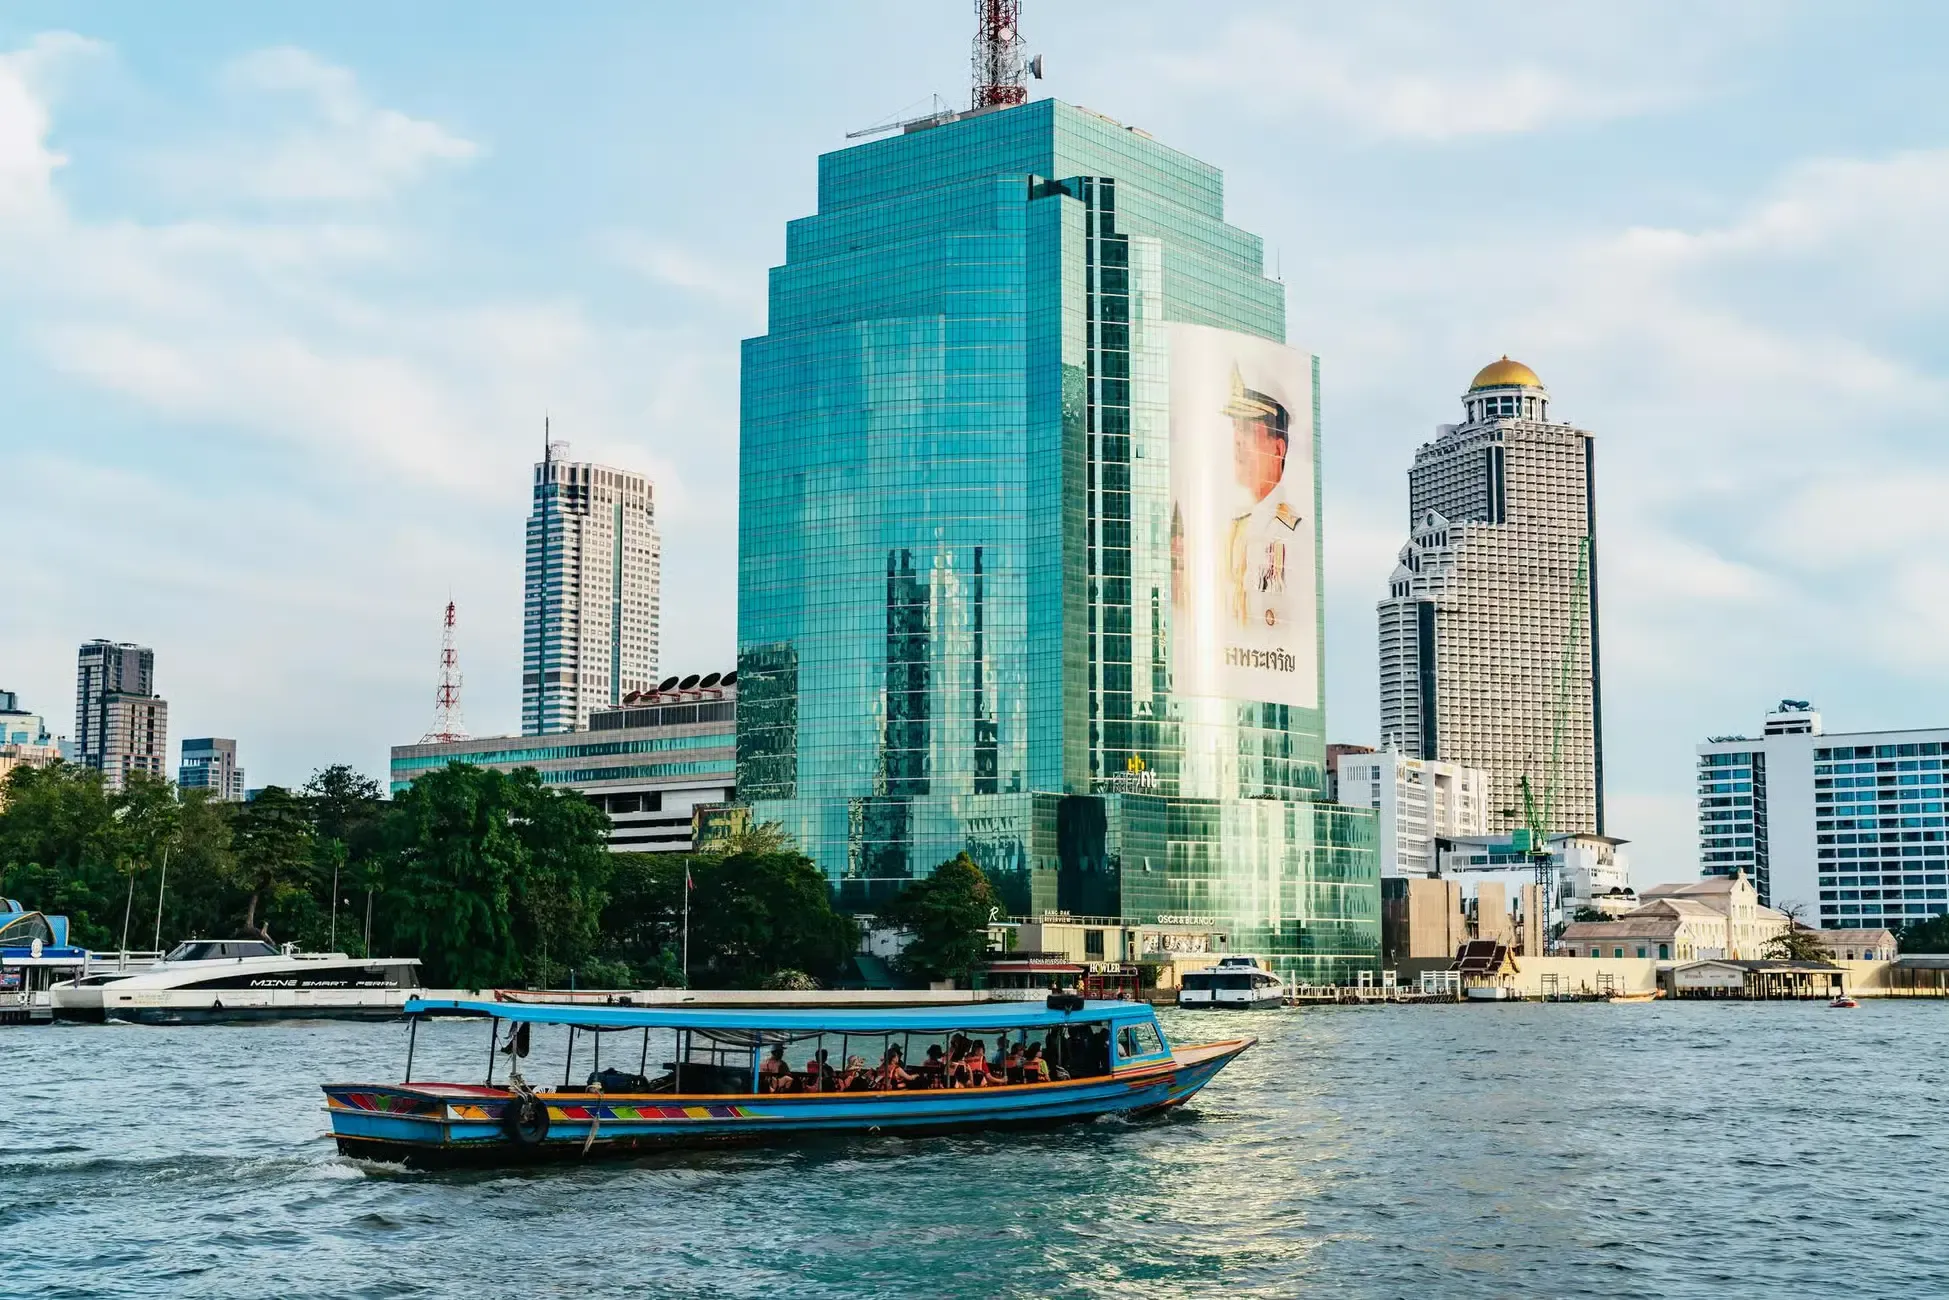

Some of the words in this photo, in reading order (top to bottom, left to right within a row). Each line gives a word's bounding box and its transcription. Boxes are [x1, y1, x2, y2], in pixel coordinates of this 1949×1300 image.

[1185, 916, 1215, 926] BLANCO
[1089, 962, 1121, 973] HOWLER
[250, 979, 298, 987] MINE
